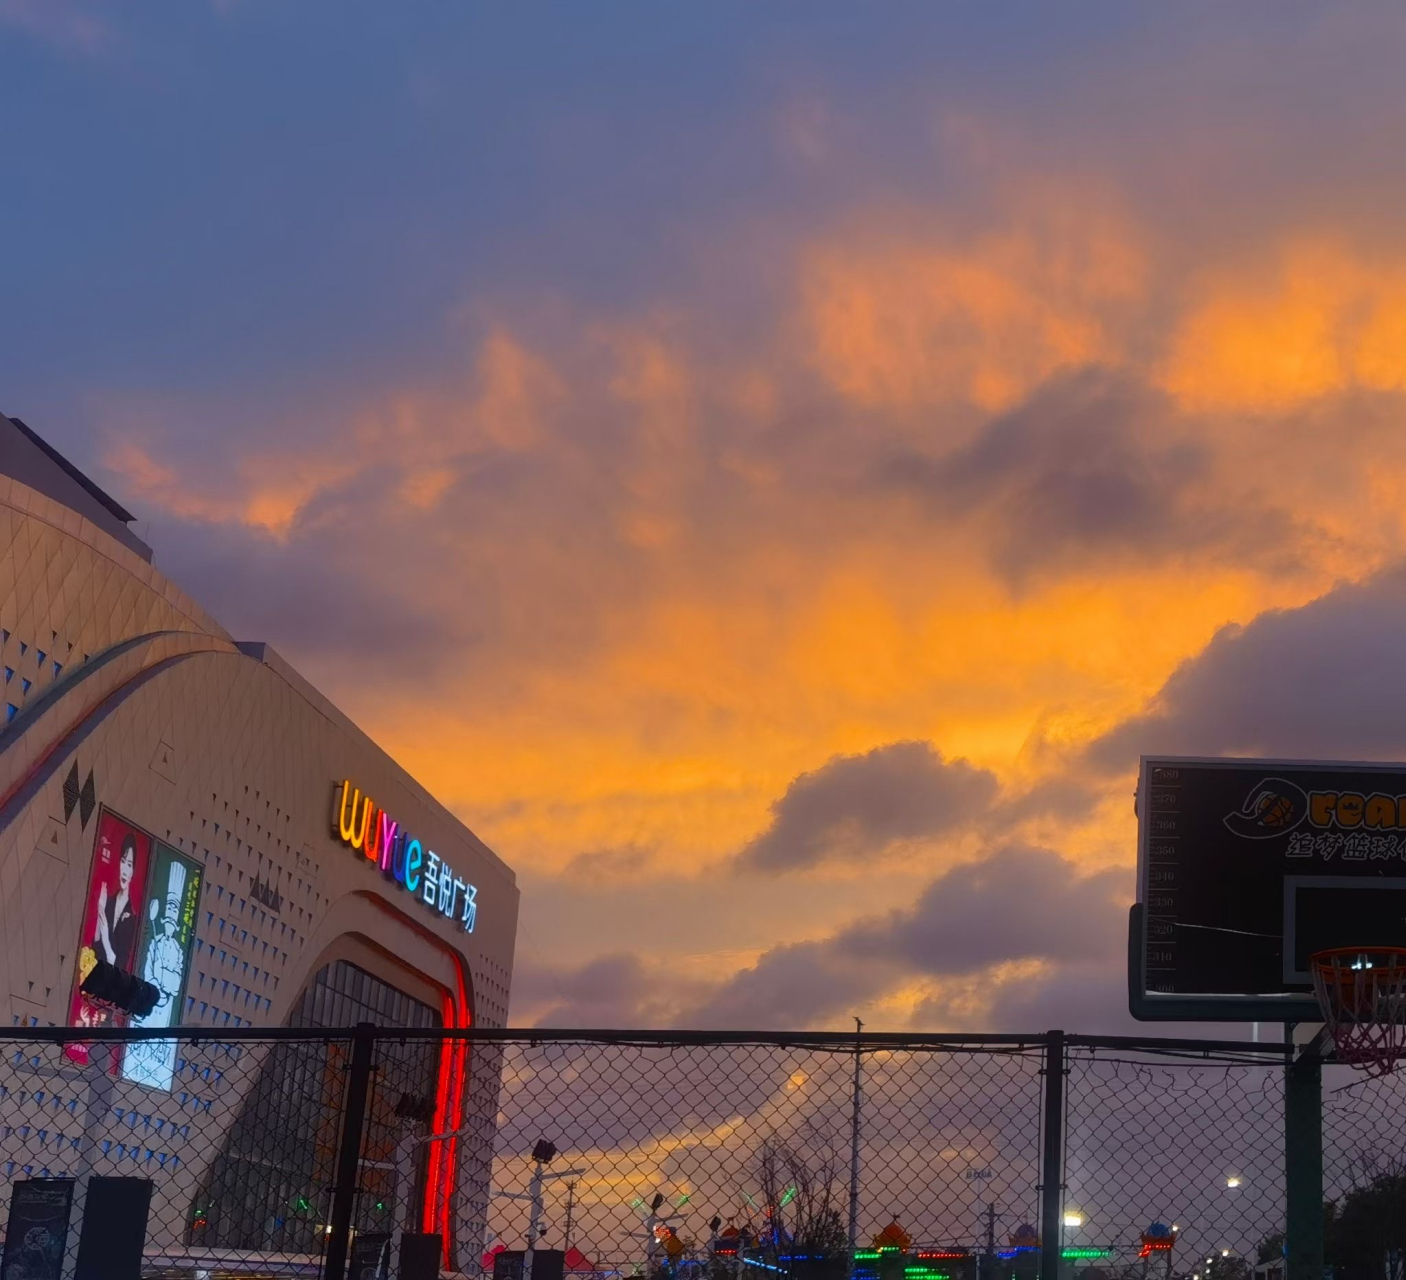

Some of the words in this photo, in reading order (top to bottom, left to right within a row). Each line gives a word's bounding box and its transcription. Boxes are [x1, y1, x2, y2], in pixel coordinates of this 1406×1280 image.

[1156, 846, 1175, 856] 350
[423, 850, 478, 934] 吾悦广场
[1154, 898, 1174, 907] 330
